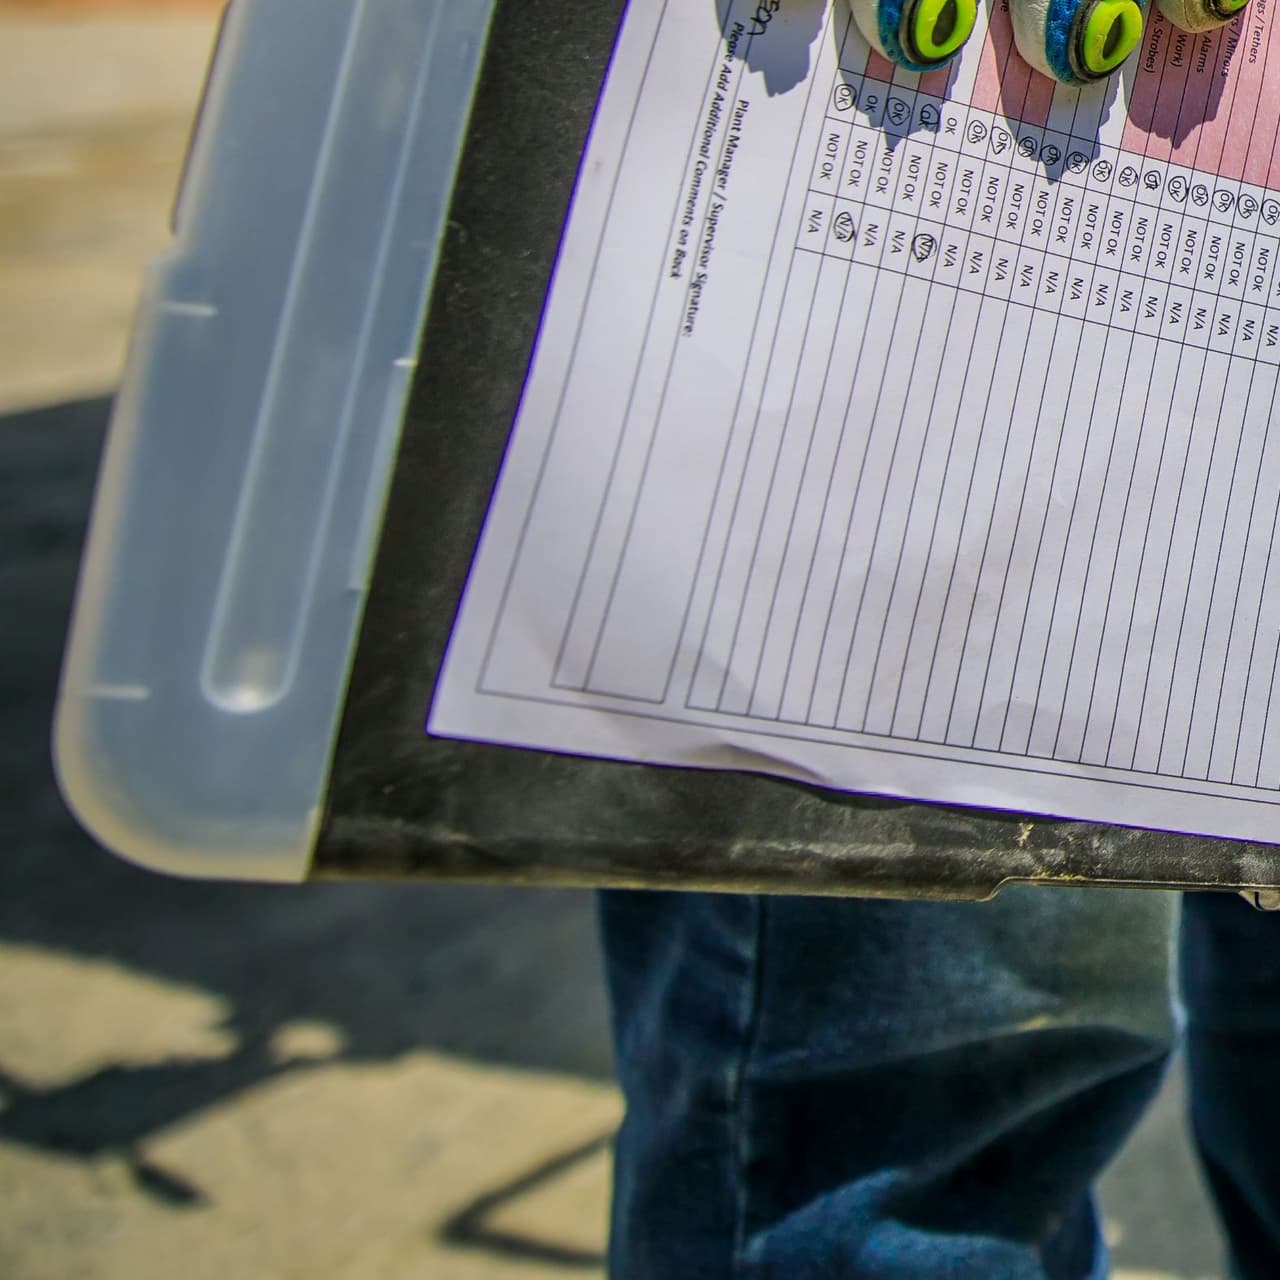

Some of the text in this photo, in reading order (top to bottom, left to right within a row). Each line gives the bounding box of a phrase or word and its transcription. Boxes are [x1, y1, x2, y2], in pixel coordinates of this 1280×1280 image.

[1142, 27, 1162, 73] Strobes)
[1170, 33, 1187, 66] Work)
[1197, 36, 1211, 73] Alarms
[1221, 37, 1237, 77] Mirrors
[1249, 25, 1262, 63] Tethers
[865, 95, 878, 112] OK
[944, 116, 957, 134] OK
[670, 22, 744, 279] Please Add Additional Comments on Back
[848, 140, 867, 187] NOT OK
[928, 161, 948, 208] NOT OK
[682, 99, 749, 337] Plant Manager Supervisor Signature:
[1030, 190, 1049, 236] NOT OK
[1105, 210, 1123, 256] NOT OK
[1019, 264, 1034, 288] N/A
[1252, 247, 1269, 291] NOT OK
[1093, 283, 1109, 307] N/A
[1240, 318, 1255, 342] N/A
